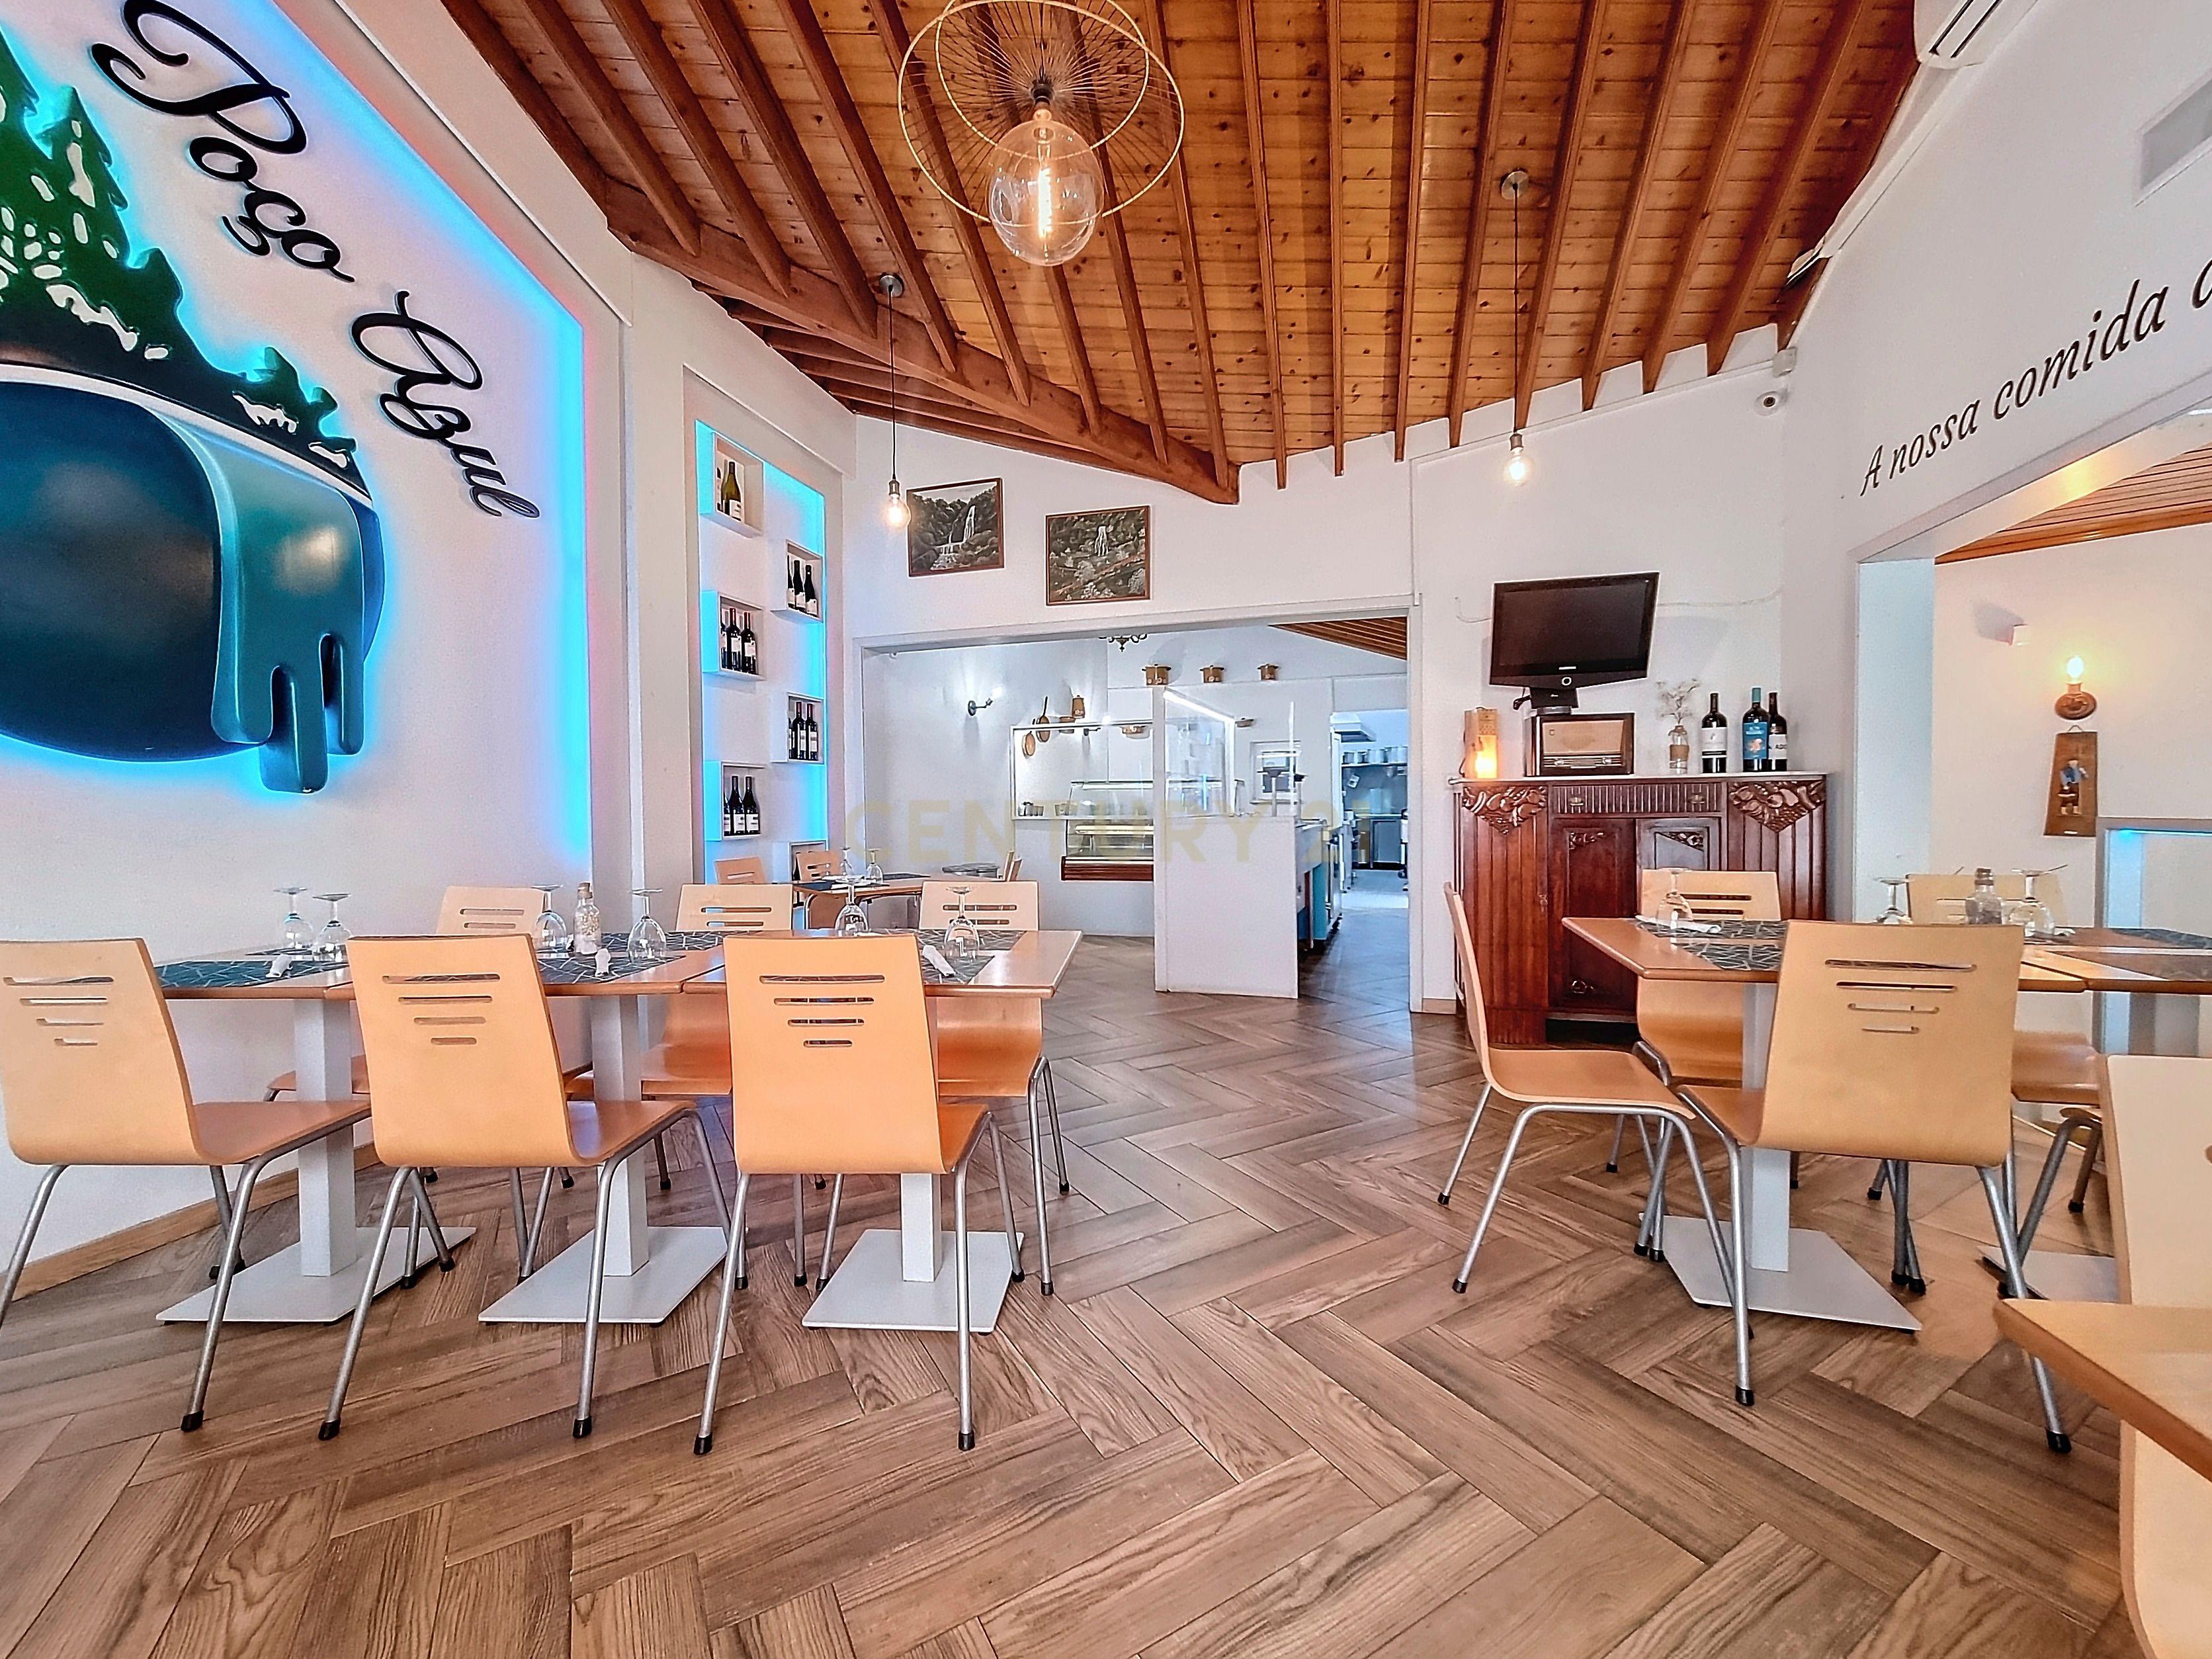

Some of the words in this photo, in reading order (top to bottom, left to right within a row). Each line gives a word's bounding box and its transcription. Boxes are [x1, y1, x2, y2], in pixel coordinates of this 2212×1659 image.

[90, 0, 355, 282] Poço
[351, 290, 540, 518] Azul
[1859, 445, 1883, 497] A
[1889, 400, 1980, 480] nossa
[1994, 278, 2169, 420] comida
